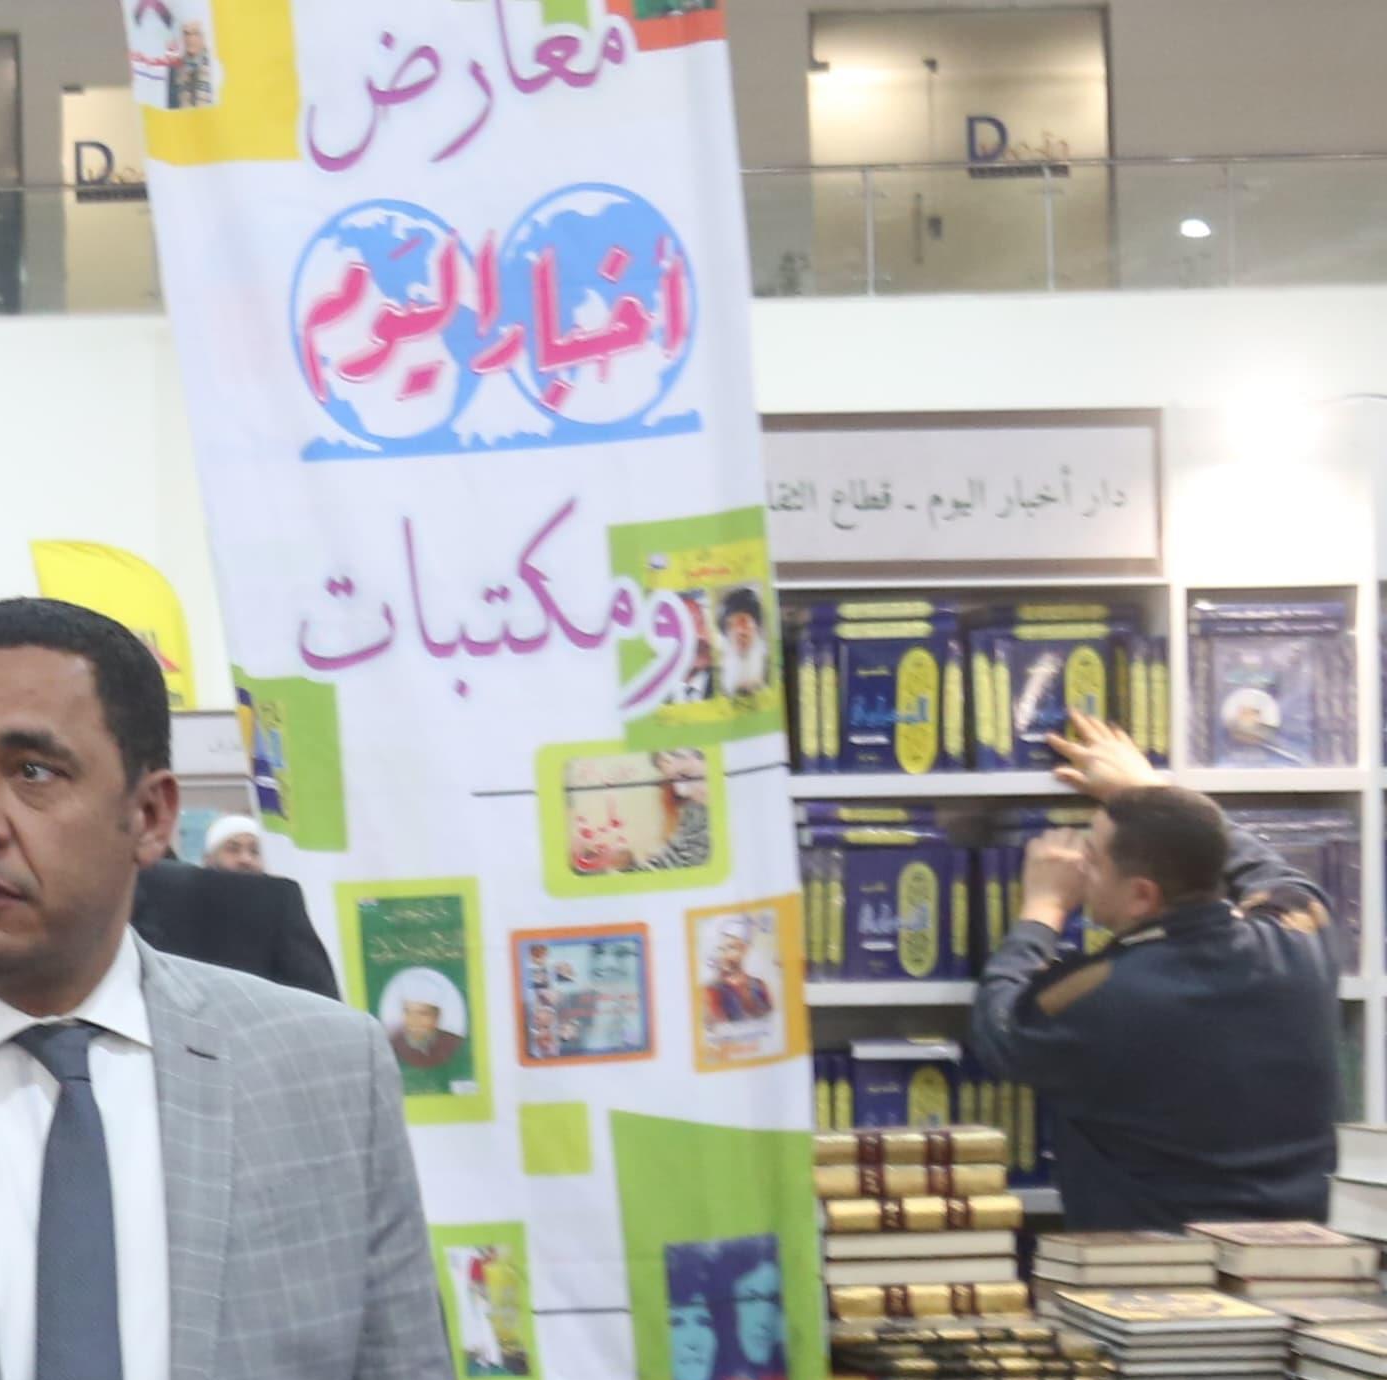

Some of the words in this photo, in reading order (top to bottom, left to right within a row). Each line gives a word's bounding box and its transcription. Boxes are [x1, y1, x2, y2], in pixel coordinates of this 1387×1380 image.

[306, 0, 631, 172] معارض
[300, 228, 497, 404] اليوم
[470, 236, 688, 413] أخبار
[927, 477, 987, 531] اليوم
[994, 463, 1073, 519] أخبار
[1081, 477, 1126, 518] دار
[299, 498, 695, 710] ومكتبات
